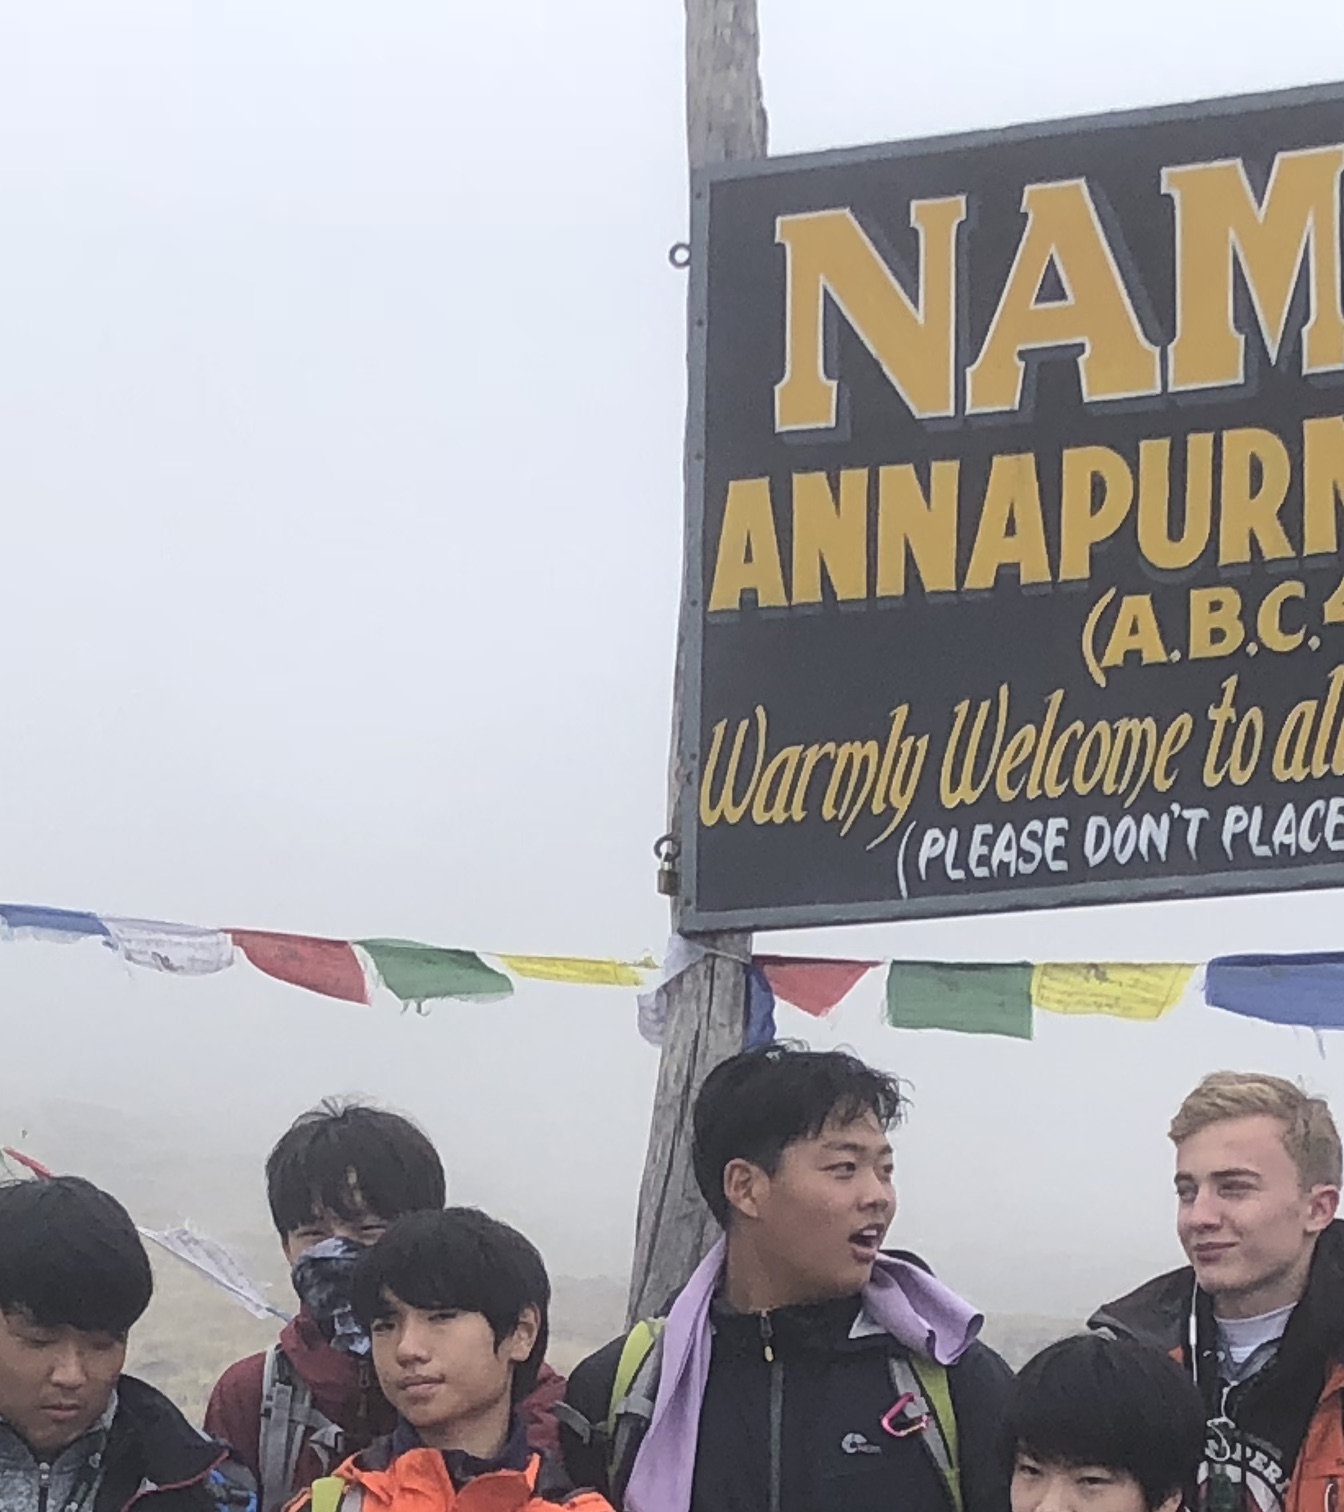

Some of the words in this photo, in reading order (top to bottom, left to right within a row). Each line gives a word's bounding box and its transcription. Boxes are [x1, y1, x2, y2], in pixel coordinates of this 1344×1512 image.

[699, 701, 930, 851] Warmly
[941, 685, 1193, 810] Welcome
[1204, 674, 1264, 789] to
[897, 820, 1069, 900] (PLEASE
[1083, 801, 1209, 865] DON'T
